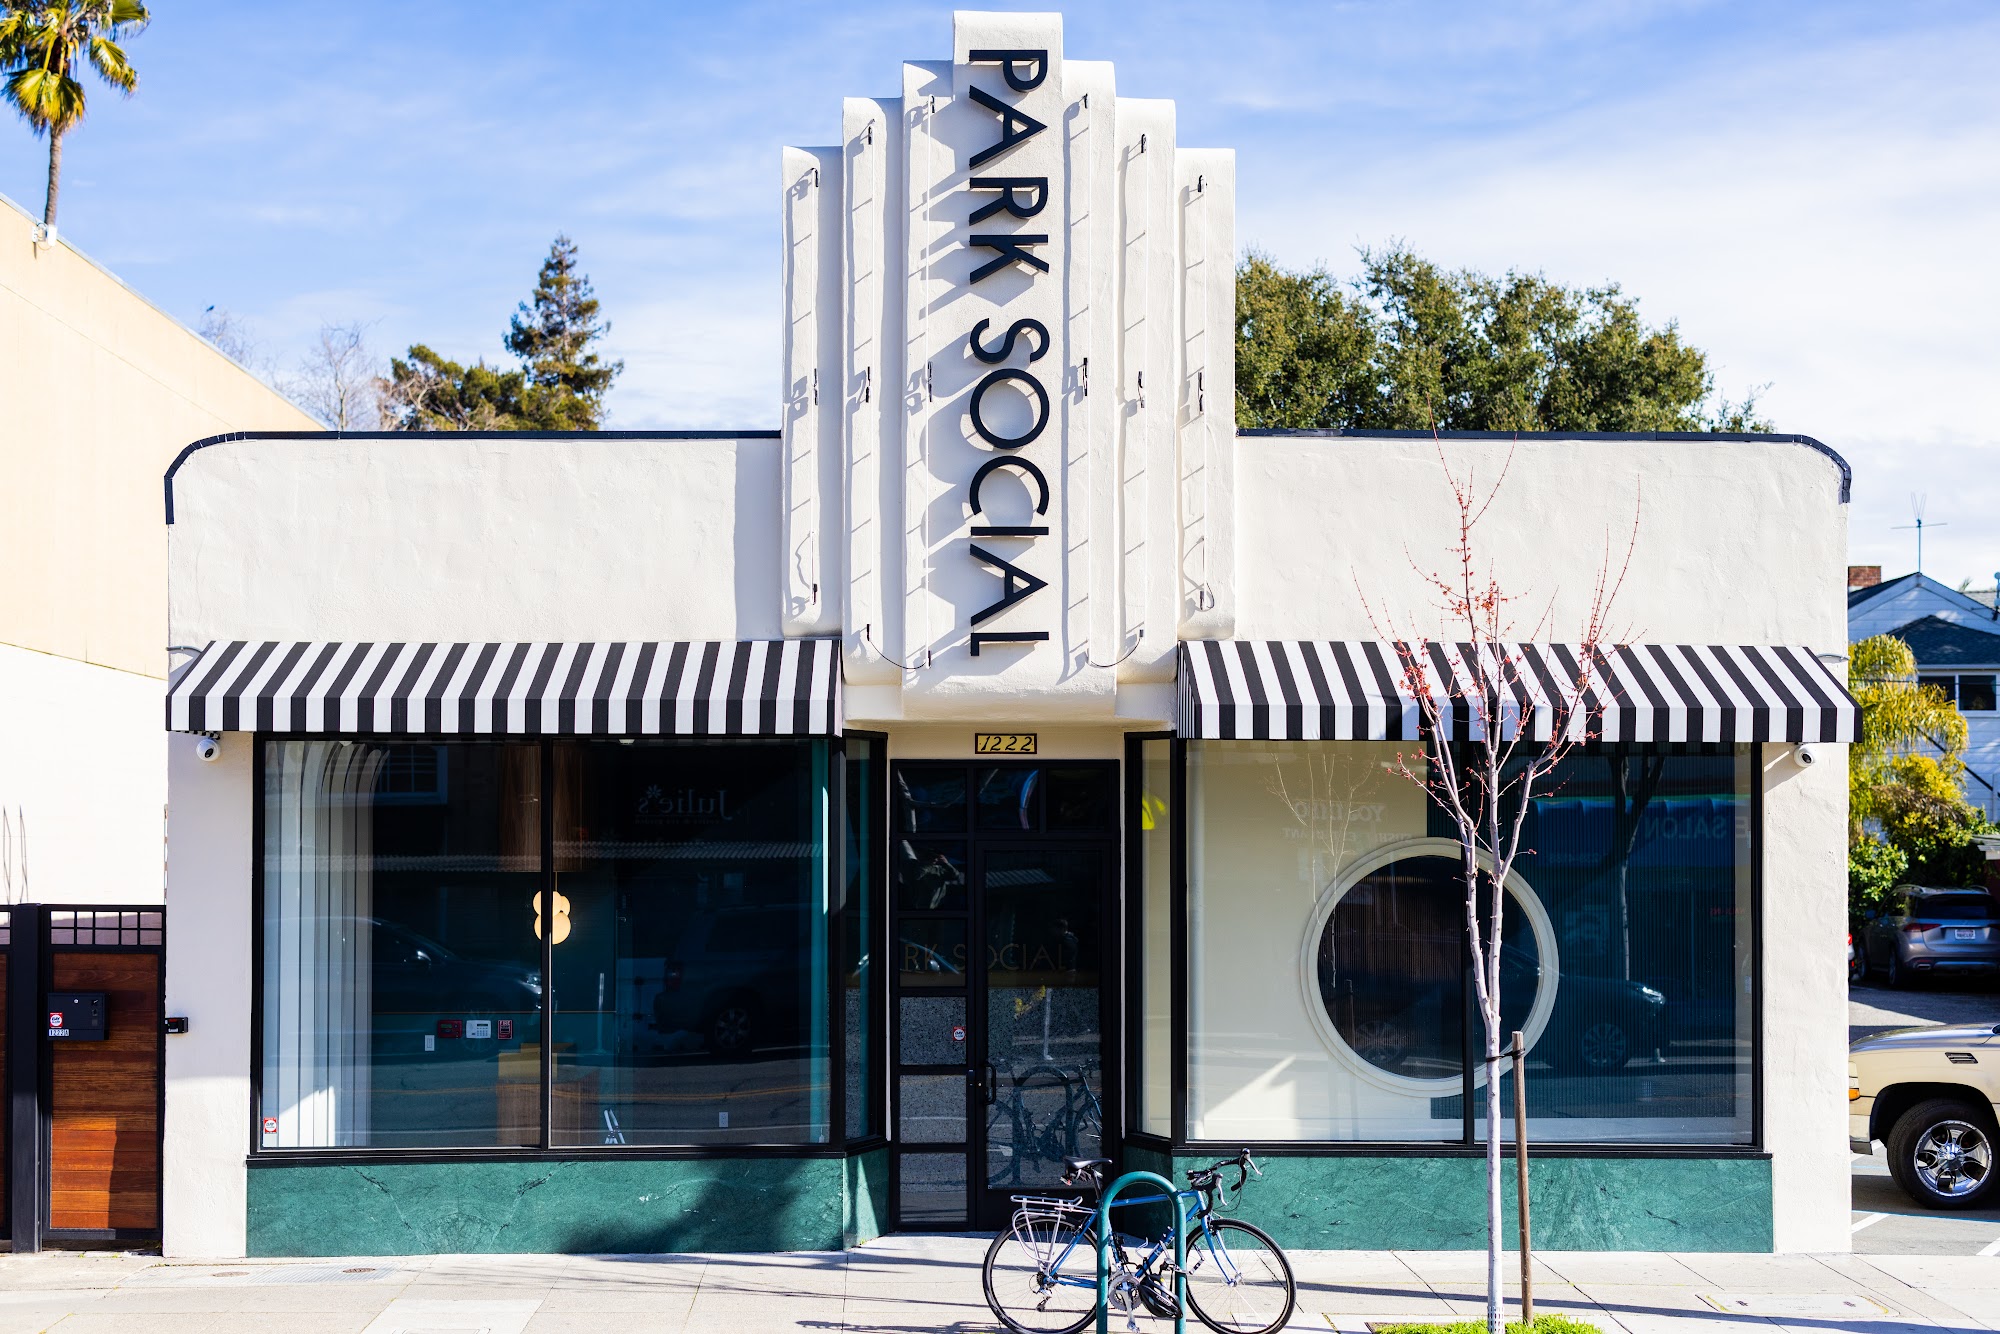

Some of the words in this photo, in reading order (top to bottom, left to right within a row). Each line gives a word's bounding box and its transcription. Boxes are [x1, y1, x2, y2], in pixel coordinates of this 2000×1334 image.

[969, 48, 1049, 285] PARK
[969, 317, 1050, 657] SOCIAL
[980, 735, 1033, 751] 1222
